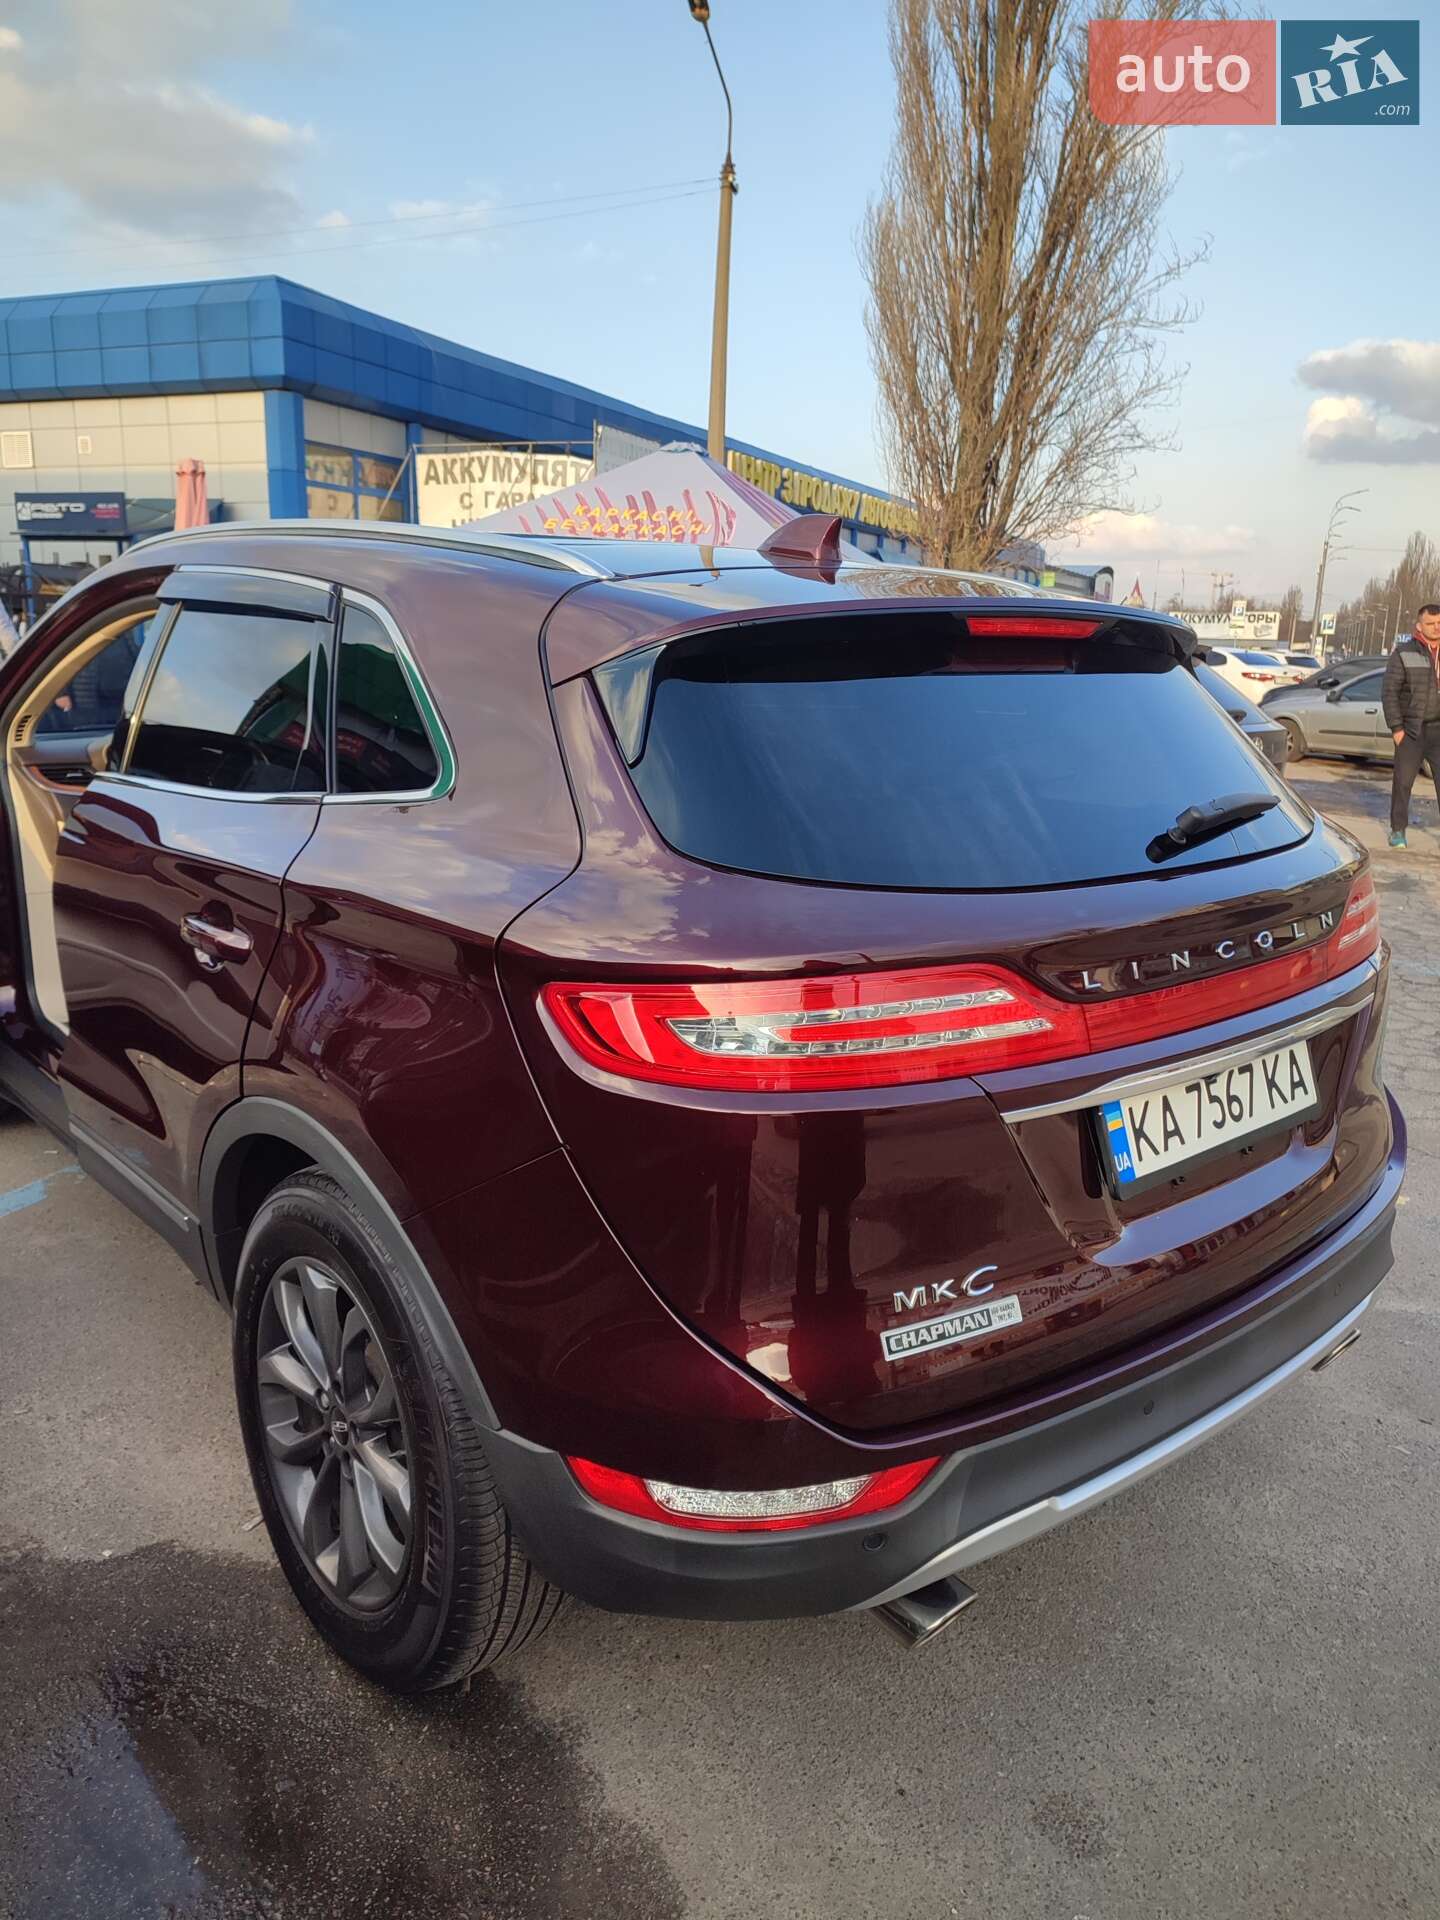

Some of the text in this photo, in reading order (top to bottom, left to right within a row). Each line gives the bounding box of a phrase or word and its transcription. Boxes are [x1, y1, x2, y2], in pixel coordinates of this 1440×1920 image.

[423, 453, 596, 487] АККУМУЛЯТ
[1081, 911, 1334, 991] LINCOLN
[1128, 1048, 1309, 1162] KA 7567 KA
[1113, 1151, 1132, 1173] UA
[892, 1265, 998, 1313] MKC
[888, 1309, 991, 1353] CHAPMAN
